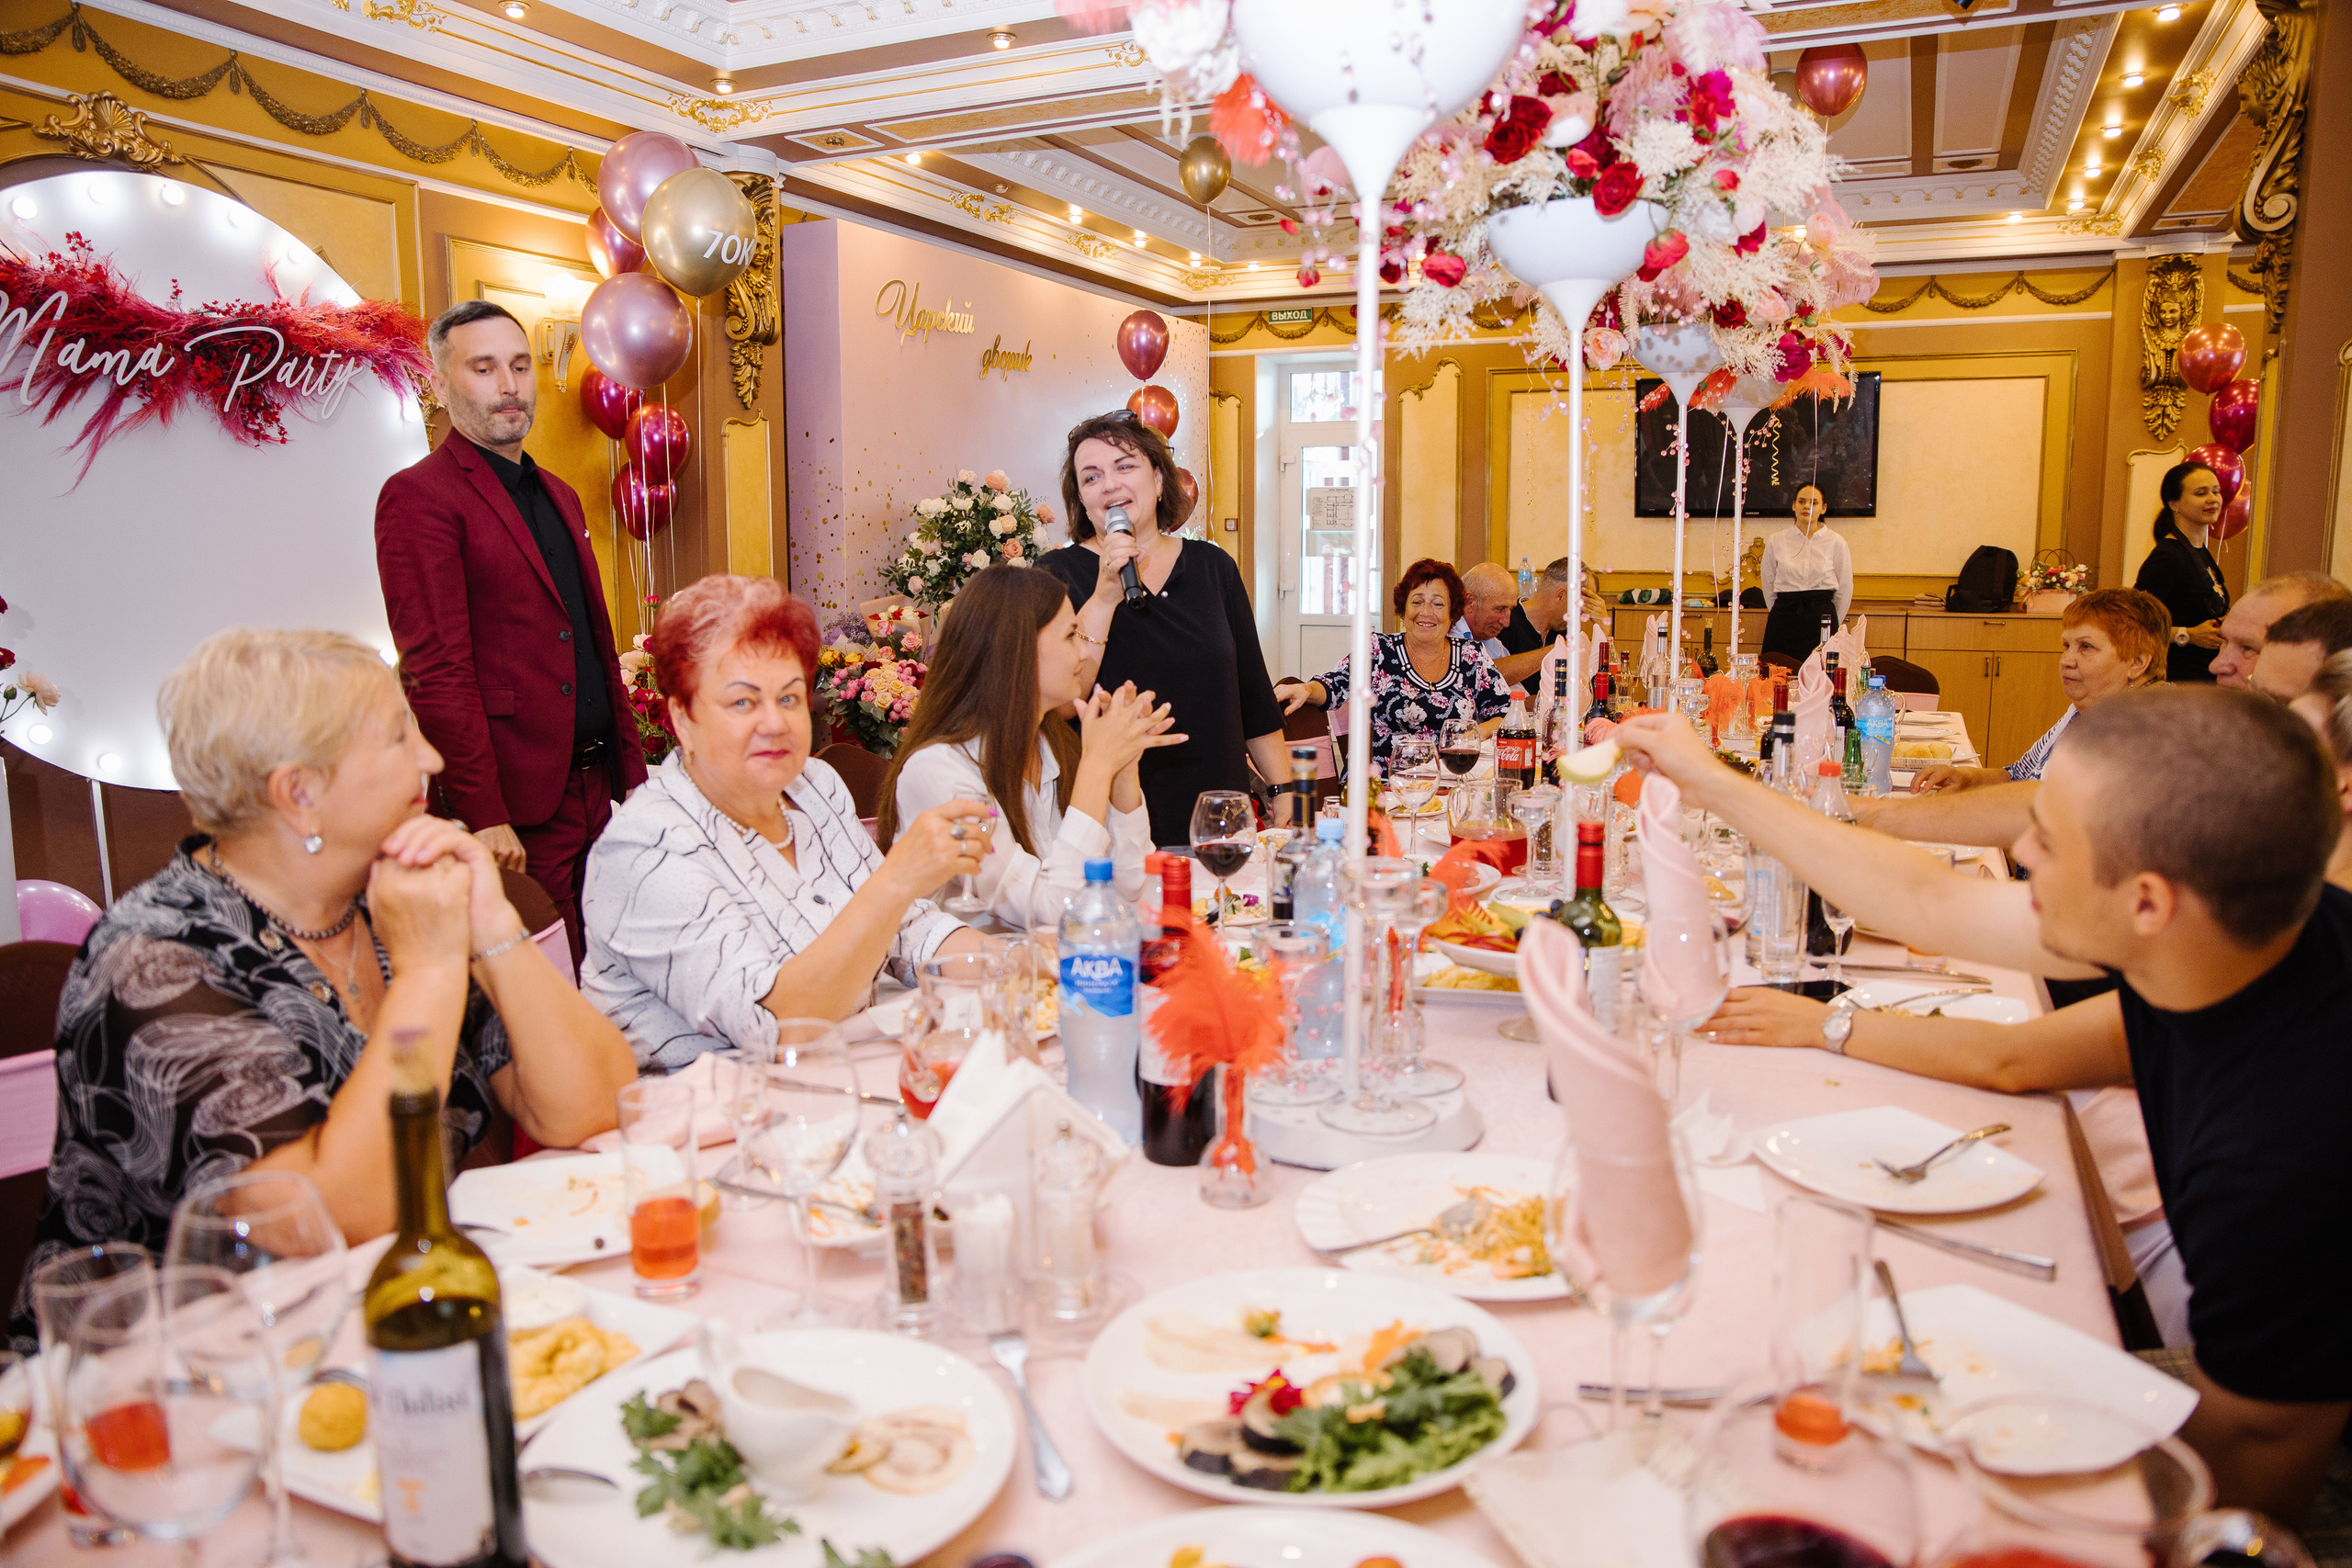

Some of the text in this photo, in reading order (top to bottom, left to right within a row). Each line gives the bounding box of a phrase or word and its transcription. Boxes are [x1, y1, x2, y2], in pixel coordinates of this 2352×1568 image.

[703, 229, 754, 266] 70K
[876, 279, 975, 347] Царский
[1272, 310, 1307, 321] ВЫХОД
[0, 290, 363, 420] Mama Party
[979, 333, 1032, 382] дворик
[1070, 956, 1123, 981] АКВА
